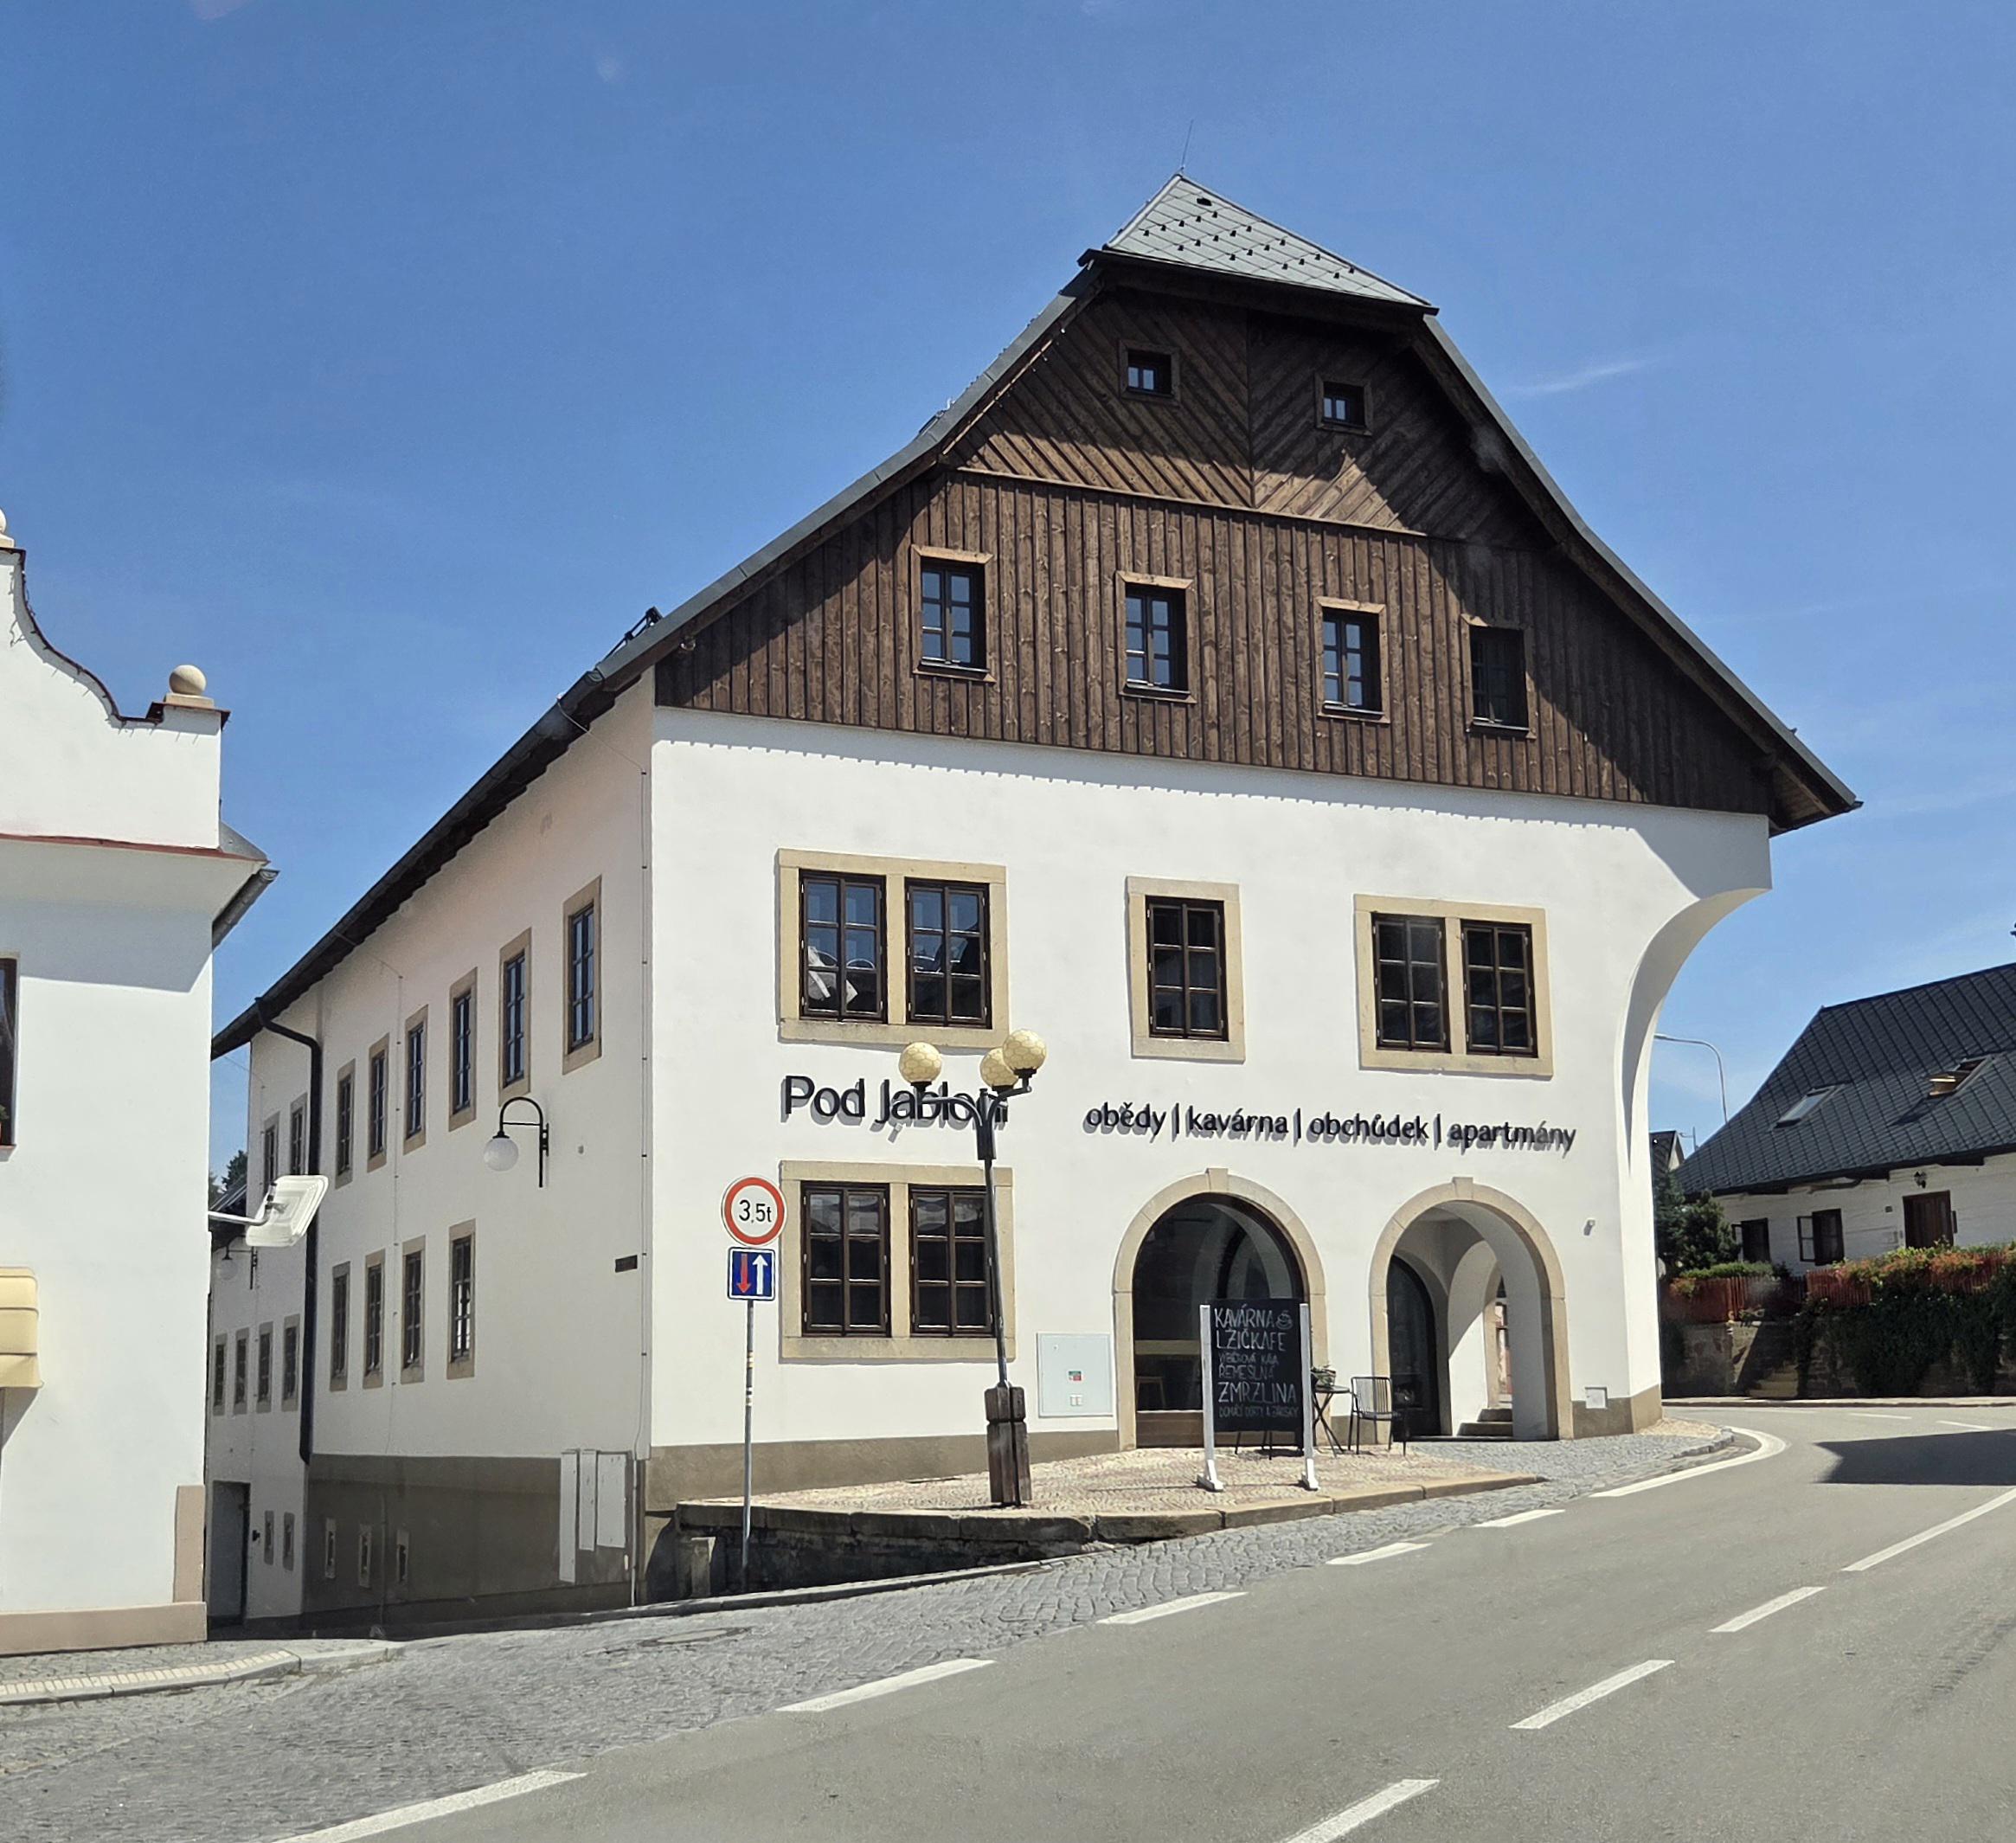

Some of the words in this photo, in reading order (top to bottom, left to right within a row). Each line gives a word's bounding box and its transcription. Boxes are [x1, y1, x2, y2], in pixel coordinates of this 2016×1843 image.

[785, 1075, 865, 1118] Pod
[1085, 1101, 1166, 1136] obědy
[1188, 1105, 1288, 1133] kavárna
[1310, 1111, 1430, 1140] obchůdek
[1449, 1120, 1576, 1151] apartmány
[1214, 1303, 1274, 1329] KAVÁRNA
[1218, 1381, 1297, 1404] ZMRZLINA
